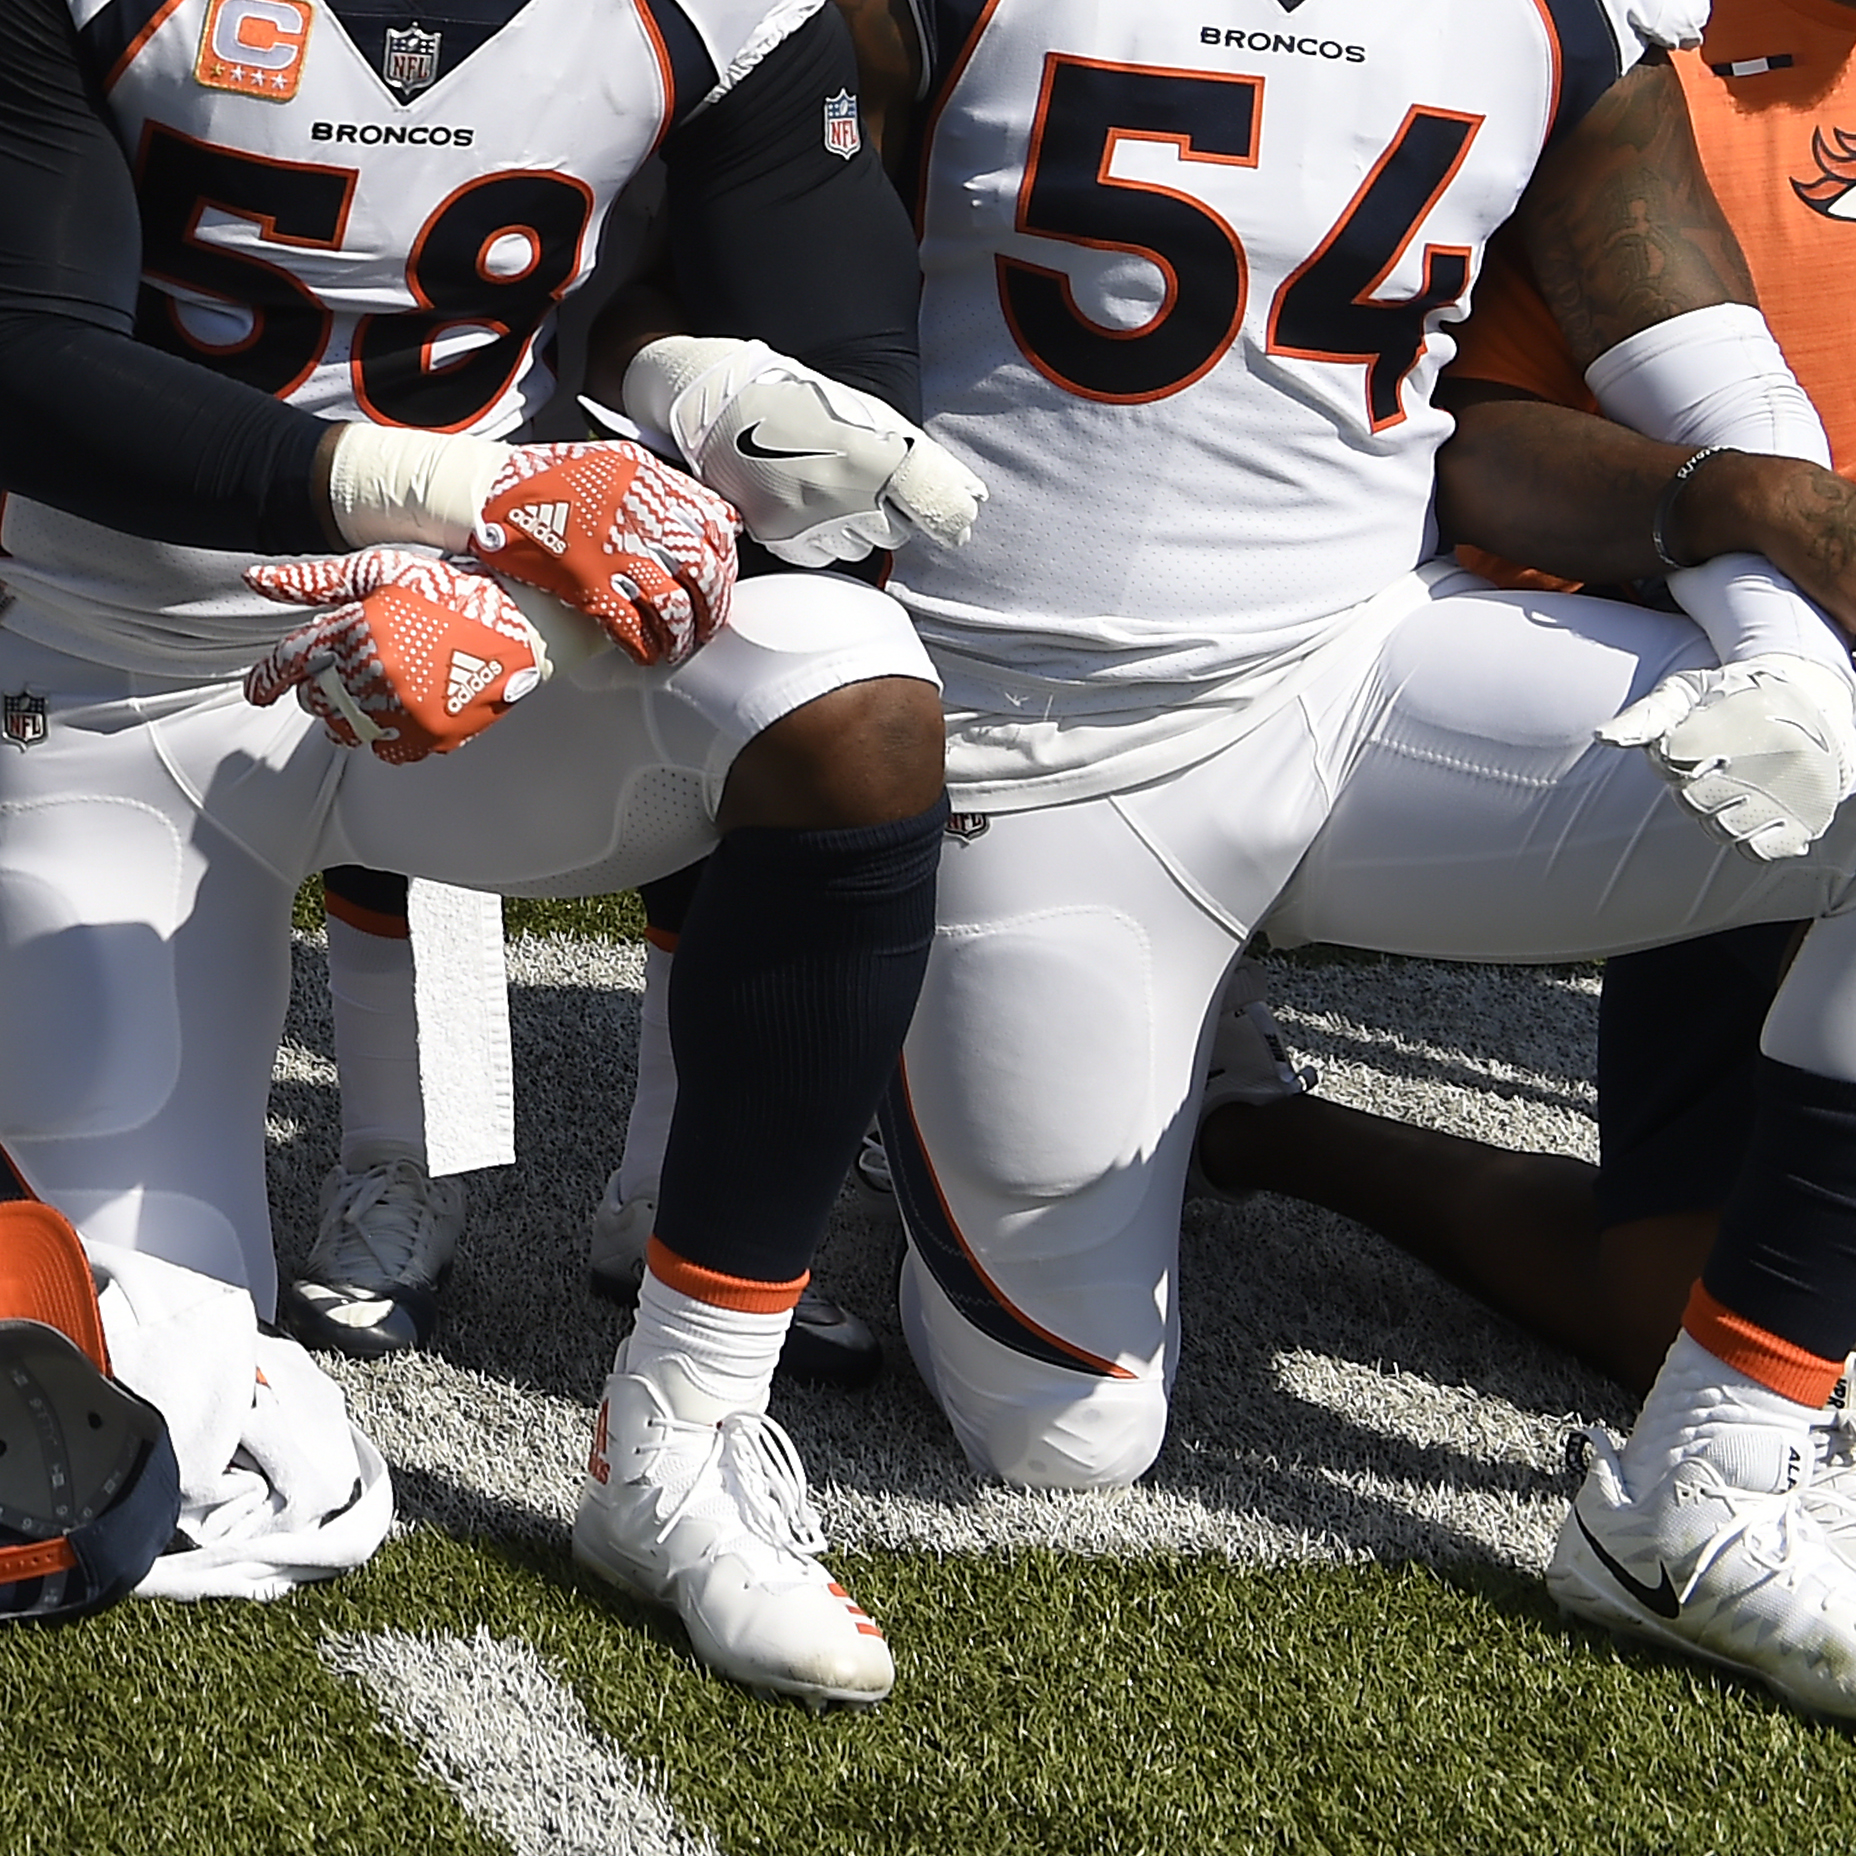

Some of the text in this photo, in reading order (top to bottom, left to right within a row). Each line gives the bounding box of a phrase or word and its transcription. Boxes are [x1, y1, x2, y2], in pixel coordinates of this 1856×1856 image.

[1199, 25, 1368, 65] BRONCOS
[391, 55, 434, 83] NFL
[310, 119, 476, 150] BRONCOS
[829, 118, 858, 146] NFL
[994, 51, 1487, 436] 54
[136, 117, 596, 436] 58
[508, 506, 570, 557] adidas
[447, 659, 505, 707] adidas
[8, 714, 44, 738] NFL
